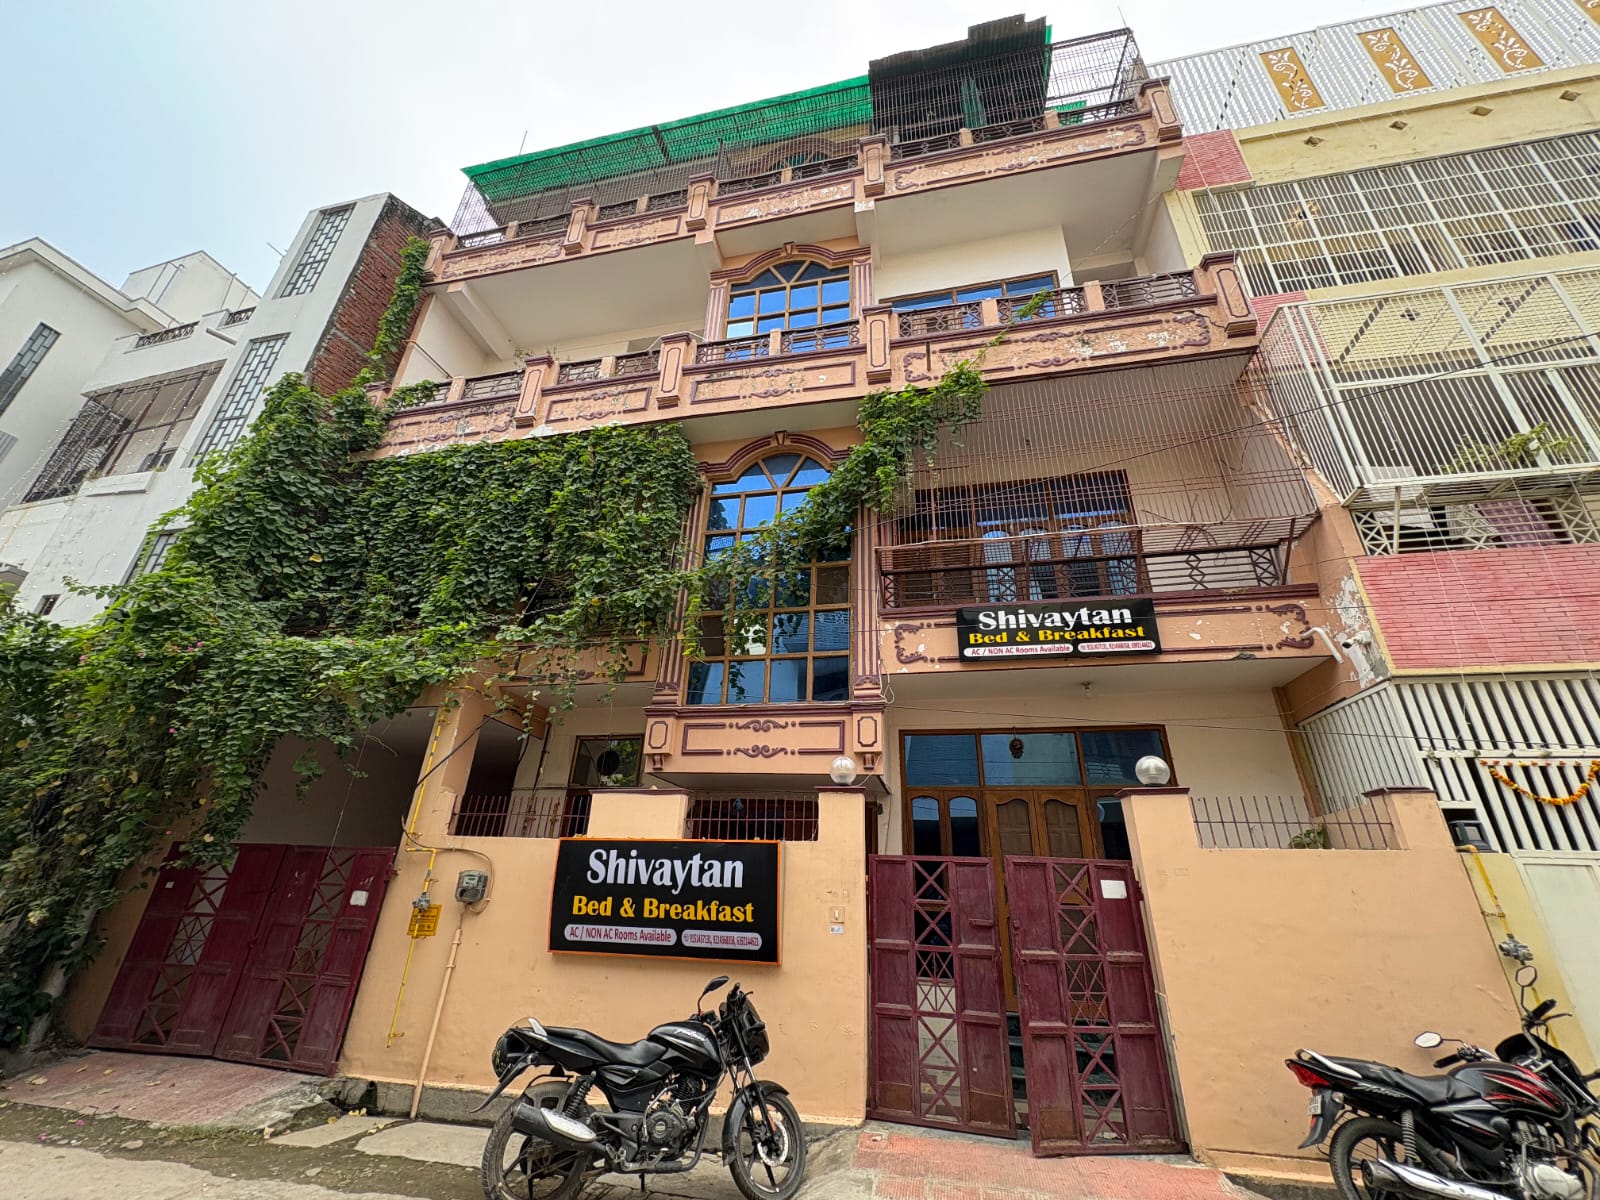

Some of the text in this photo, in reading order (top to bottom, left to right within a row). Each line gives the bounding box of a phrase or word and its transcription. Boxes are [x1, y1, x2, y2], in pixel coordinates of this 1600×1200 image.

[978, 606, 1133, 631] Shivaytan
[969, 625, 1146, 645] Bed & Breakfast
[971, 648, 981, 656] AC
[988, 647, 1004, 655] NON
[1005, 646, 1015, 654] AC
[1015, 646, 1039, 654] Rooms
[1039, 644, 1070, 653] Available
[587, 848, 744, 895] Shivaytan
[572, 895, 755, 923] Bed & Breakfast
[569, 926, 579, 938] AC
[585, 927, 602, 940] NON
[603, 928, 614, 940] AC
[614, 928, 638, 941] Rooms
[639, 929, 672, 943] Available
